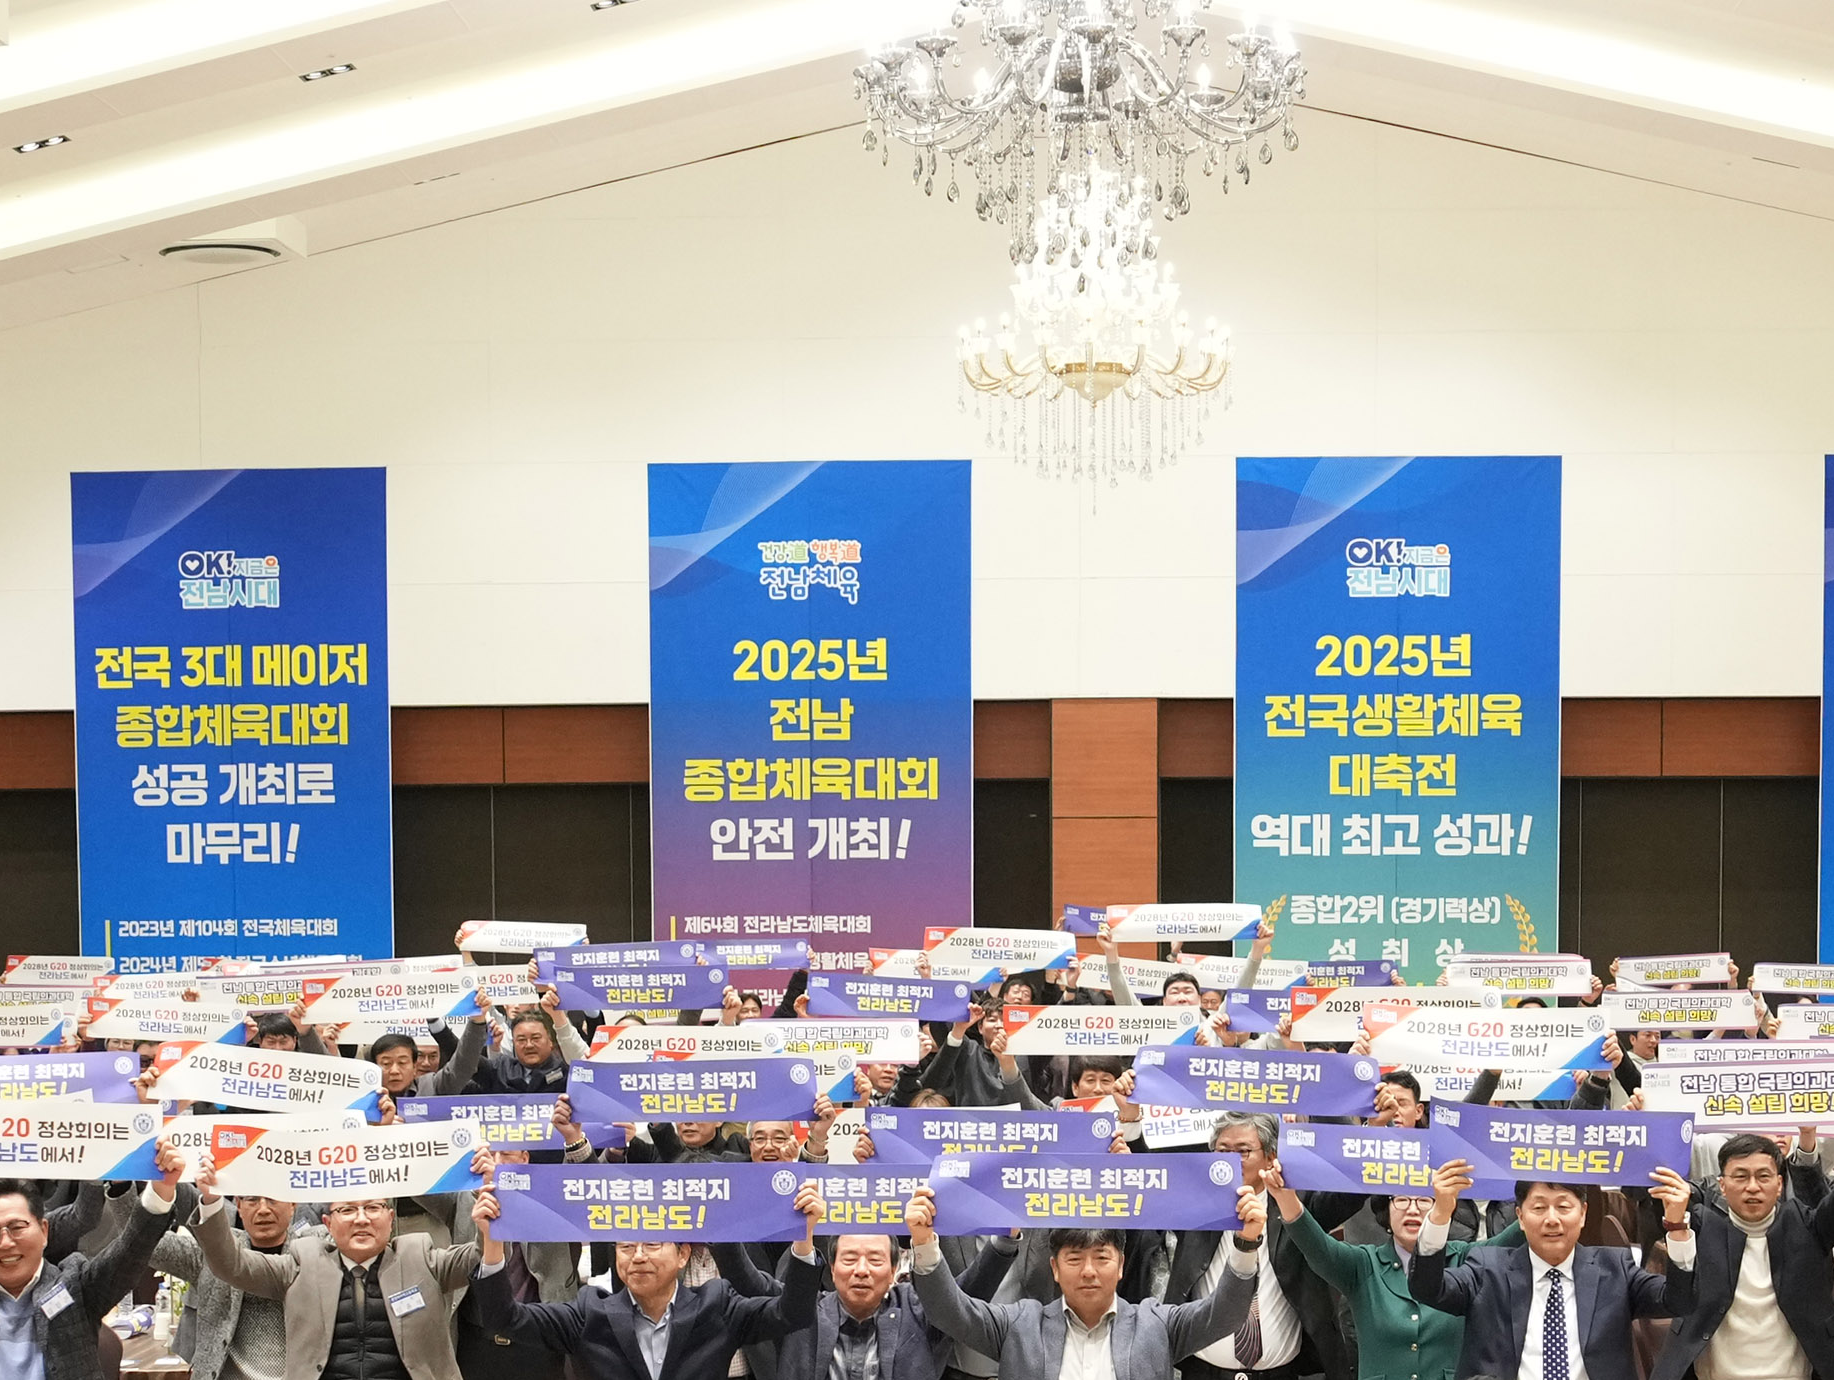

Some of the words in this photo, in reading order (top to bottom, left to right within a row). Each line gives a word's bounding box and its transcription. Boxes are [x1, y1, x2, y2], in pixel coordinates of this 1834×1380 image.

[179, 552, 234, 578] OK!
[234, 556, 279, 577] 지금은
[1346, 540, 1404, 567] OK!
[1404, 544, 1450, 565] 지금은
[180, 579, 279, 609] 전남시대
[760, 567, 859, 603] 전남체육
[1347, 567, 1450, 597] 전남시대
[95, 647, 171, 688] 전국
[181, 645, 242, 687] 3대
[252, 644, 368, 686] 메이저
[733, 638, 888, 681] 2025년
[1315, 634, 1471, 677] 2025년
[116, 704, 349, 747] 종합체육대회
[769, 699, 854, 741] 전남
[1264, 694, 1522, 737] 전국생활체육
[132, 764, 208, 806] 성공
[219, 763, 335, 805] 개최로
[683, 758, 938, 802] 종합체육대회
[1330, 754, 1457, 797] 대축전
[167, 823, 299, 864] 마무리!
[710, 818, 794, 861] 안전
[808, 818, 911, 860] 개최!
[1251, 815, 1330, 856] 역대
[1342, 814, 1420, 856] 최고
[1433, 814, 1533, 856] 성과!
[1290, 895, 1383, 924] 종합2위
[1392, 895, 1501, 924] (경기력상)
[119, 920, 174, 938] 2023년
[179, 919, 238, 937] 제104회
[243, 918, 338, 937] 전국체육대회
[684, 916, 738, 935] 제64회
[743, 915, 871, 935] 전라남도체육대회
[38, 1119, 130, 1140] 정상회의는
[1489, 1119, 1577, 1145] 전지훈련
[1584, 1123, 1647, 1147] 최적지
[1510, 1147, 1623, 1174] 전라남도!
[563, 1178, 655, 1201] 전지훈련
[662, 1177, 730, 1200] 최적지
[1001, 1167, 1094, 1190] 전지훈련
[1100, 1167, 1167, 1190] 최적지
[588, 1206, 706, 1230] 전라남도!
[1025, 1193, 1143, 1217] 전라남도!
